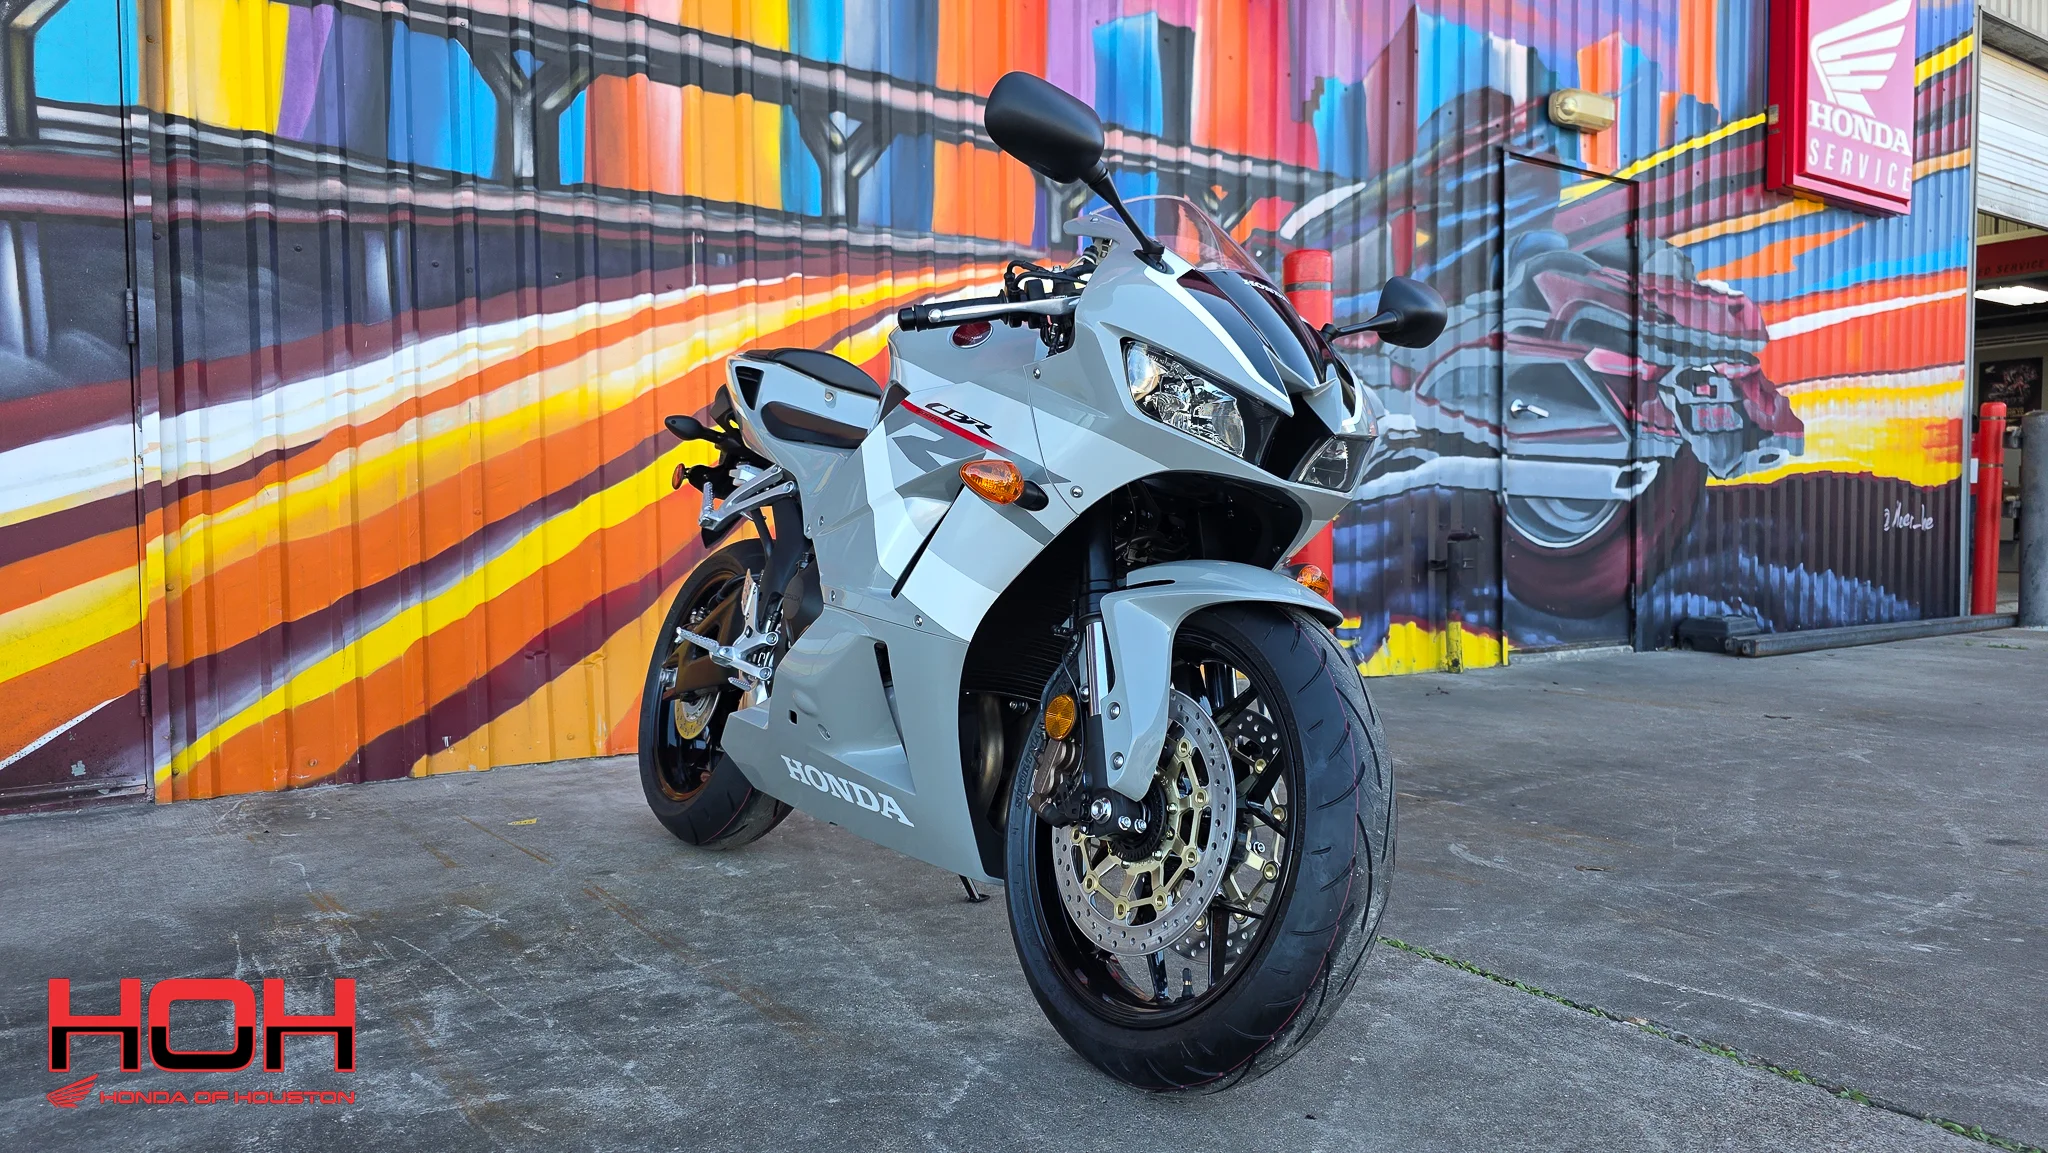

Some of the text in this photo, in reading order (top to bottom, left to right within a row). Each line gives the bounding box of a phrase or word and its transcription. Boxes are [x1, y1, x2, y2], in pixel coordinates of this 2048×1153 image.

[1808, 99, 1911, 157] HONDA
[1808, 138, 1912, 193] SERVICE
[925, 402, 993, 439] CBR
[780, 754, 915, 828] HONDA
